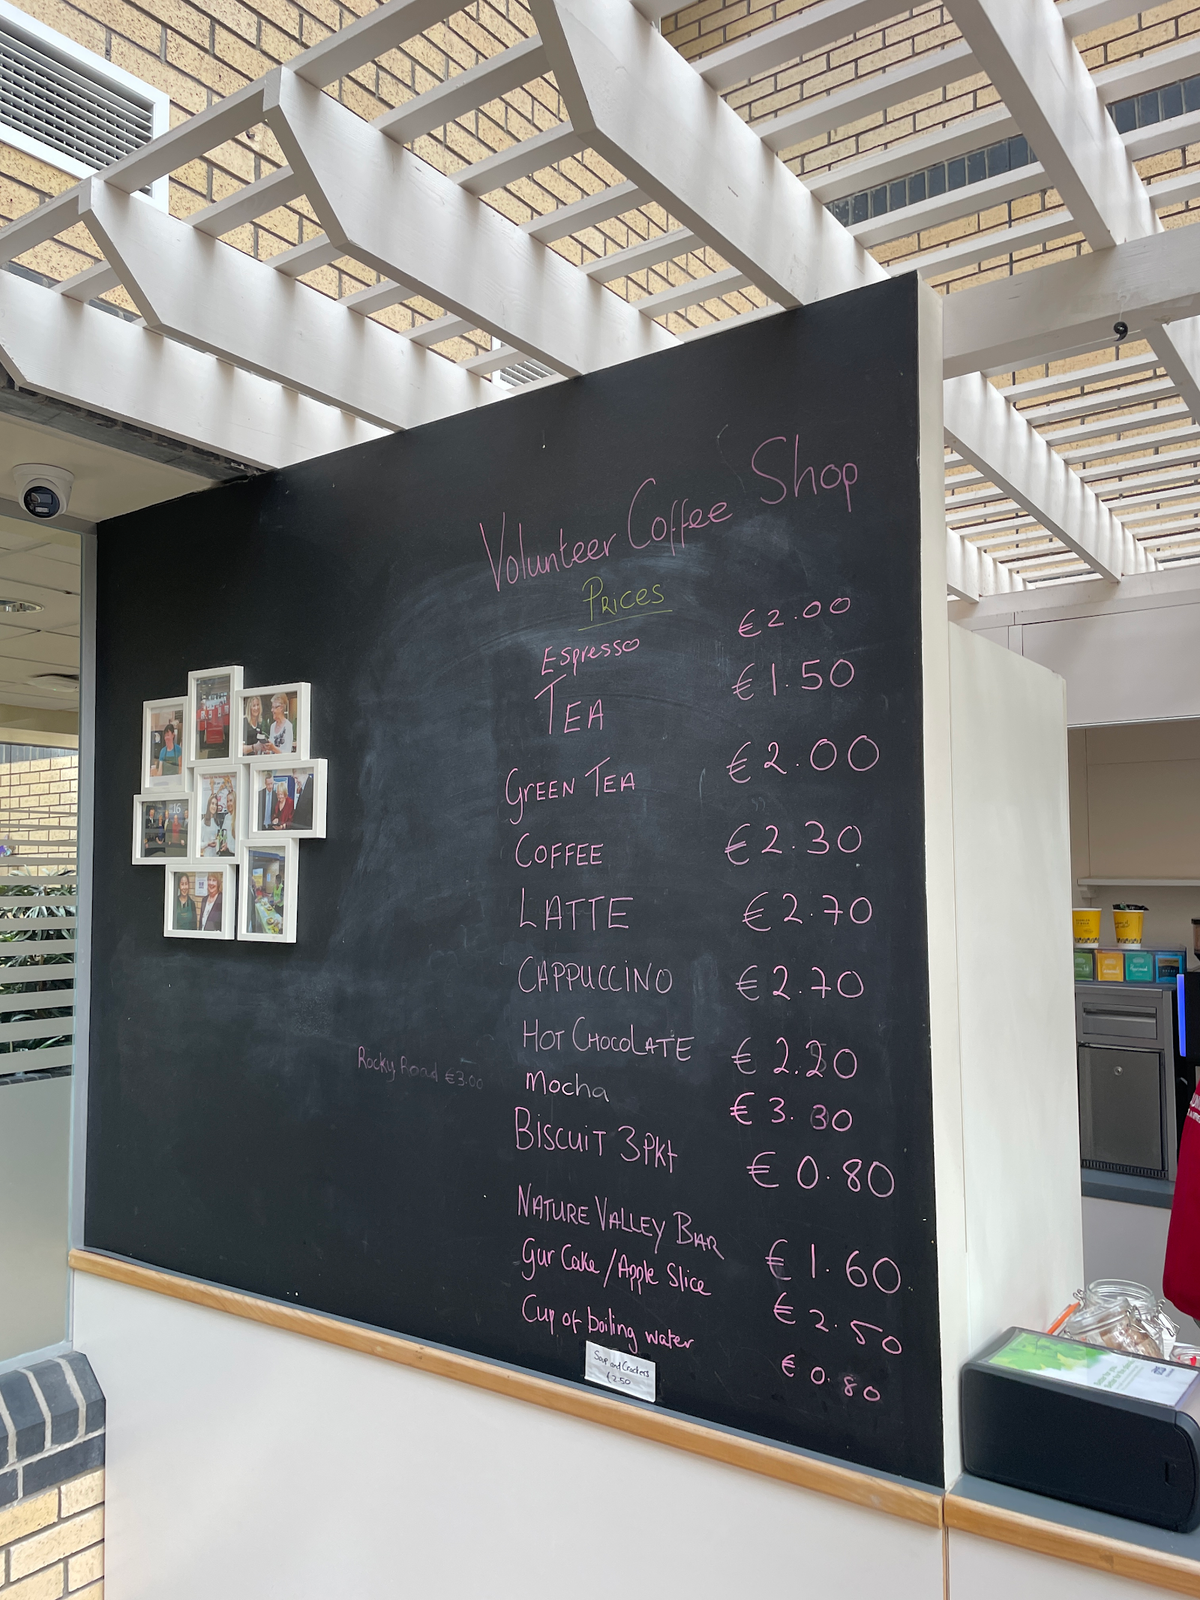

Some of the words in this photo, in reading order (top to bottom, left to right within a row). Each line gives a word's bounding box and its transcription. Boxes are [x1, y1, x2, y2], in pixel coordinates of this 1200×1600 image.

[479, 511, 617, 592] Volunteer
[627, 478, 733, 556] Coffee
[751, 434, 859, 513] Shop
[541, 638, 640, 676] Espresso
[738, 597, 851, 638] €2.00
[534, 673, 604, 735] TEA
[732, 659, 855, 701] €1.50
[584, 756, 636, 797] TEA
[726, 735, 880, 784] €2.00
[515, 832, 604, 869] COFFEE
[724, 820, 863, 865] €2.30
[519, 887, 633, 931] LATTE
[742, 891, 874, 932] €2.70
[736, 964, 865, 1002] €2.70
[523, 1018, 565, 1053] HOT
[358, 1045, 396, 1082] Rocky
[400, 1055, 438, 1082] Road
[526, 1070, 610, 1103] Mocha
[517, 1183, 591, 1226] NATURE
[595, 1195, 666, 1255] VALLEY
[561, 1243, 601, 1275] Cake
[666, 1262, 713, 1296] Slice
[521, 1293, 556, 1336] Cup
[561, 1309, 583, 1334] of
[587, 1305, 639, 1355] boiling
[644, 1328, 695, 1350] water
